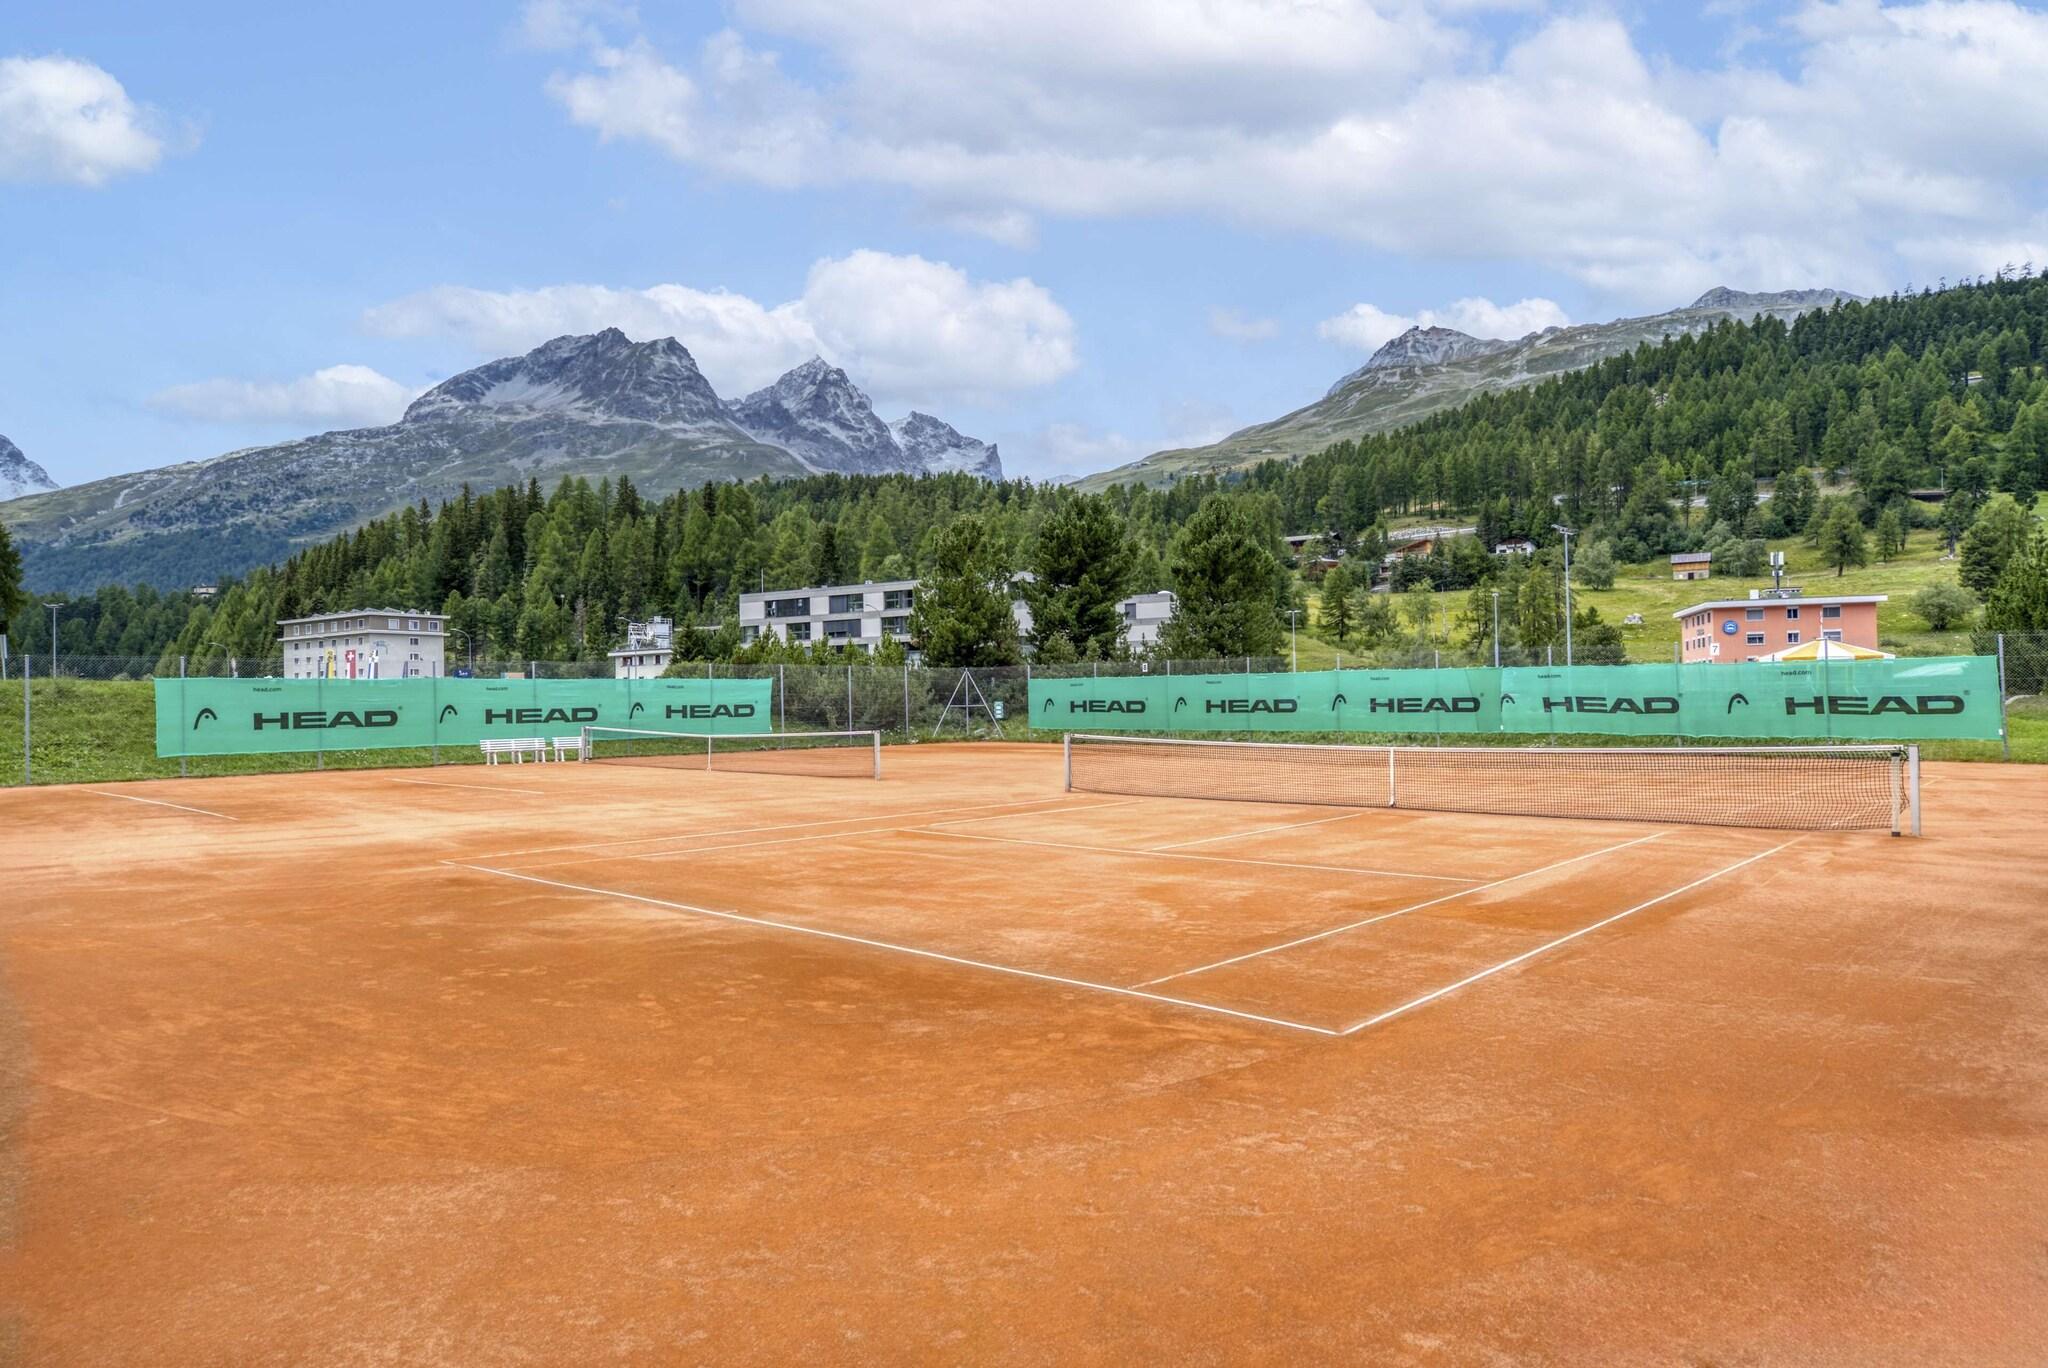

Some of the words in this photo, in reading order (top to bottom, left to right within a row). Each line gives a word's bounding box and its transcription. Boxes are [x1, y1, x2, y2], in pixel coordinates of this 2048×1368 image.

[1711, 645, 1718, 653] 7
[665, 704, 755, 718] HEAD
[1070, 700, 1146, 713] HEAD
[1206, 698, 1297, 714] HEAD
[1369, 697, 1481, 713] HEAD
[1542, 696, 1680, 714] HEAD
[1784, 695, 1965, 715] HEAD
[254, 711, 398, 730] HEAD
[485, 708, 598, 725] HEAD
